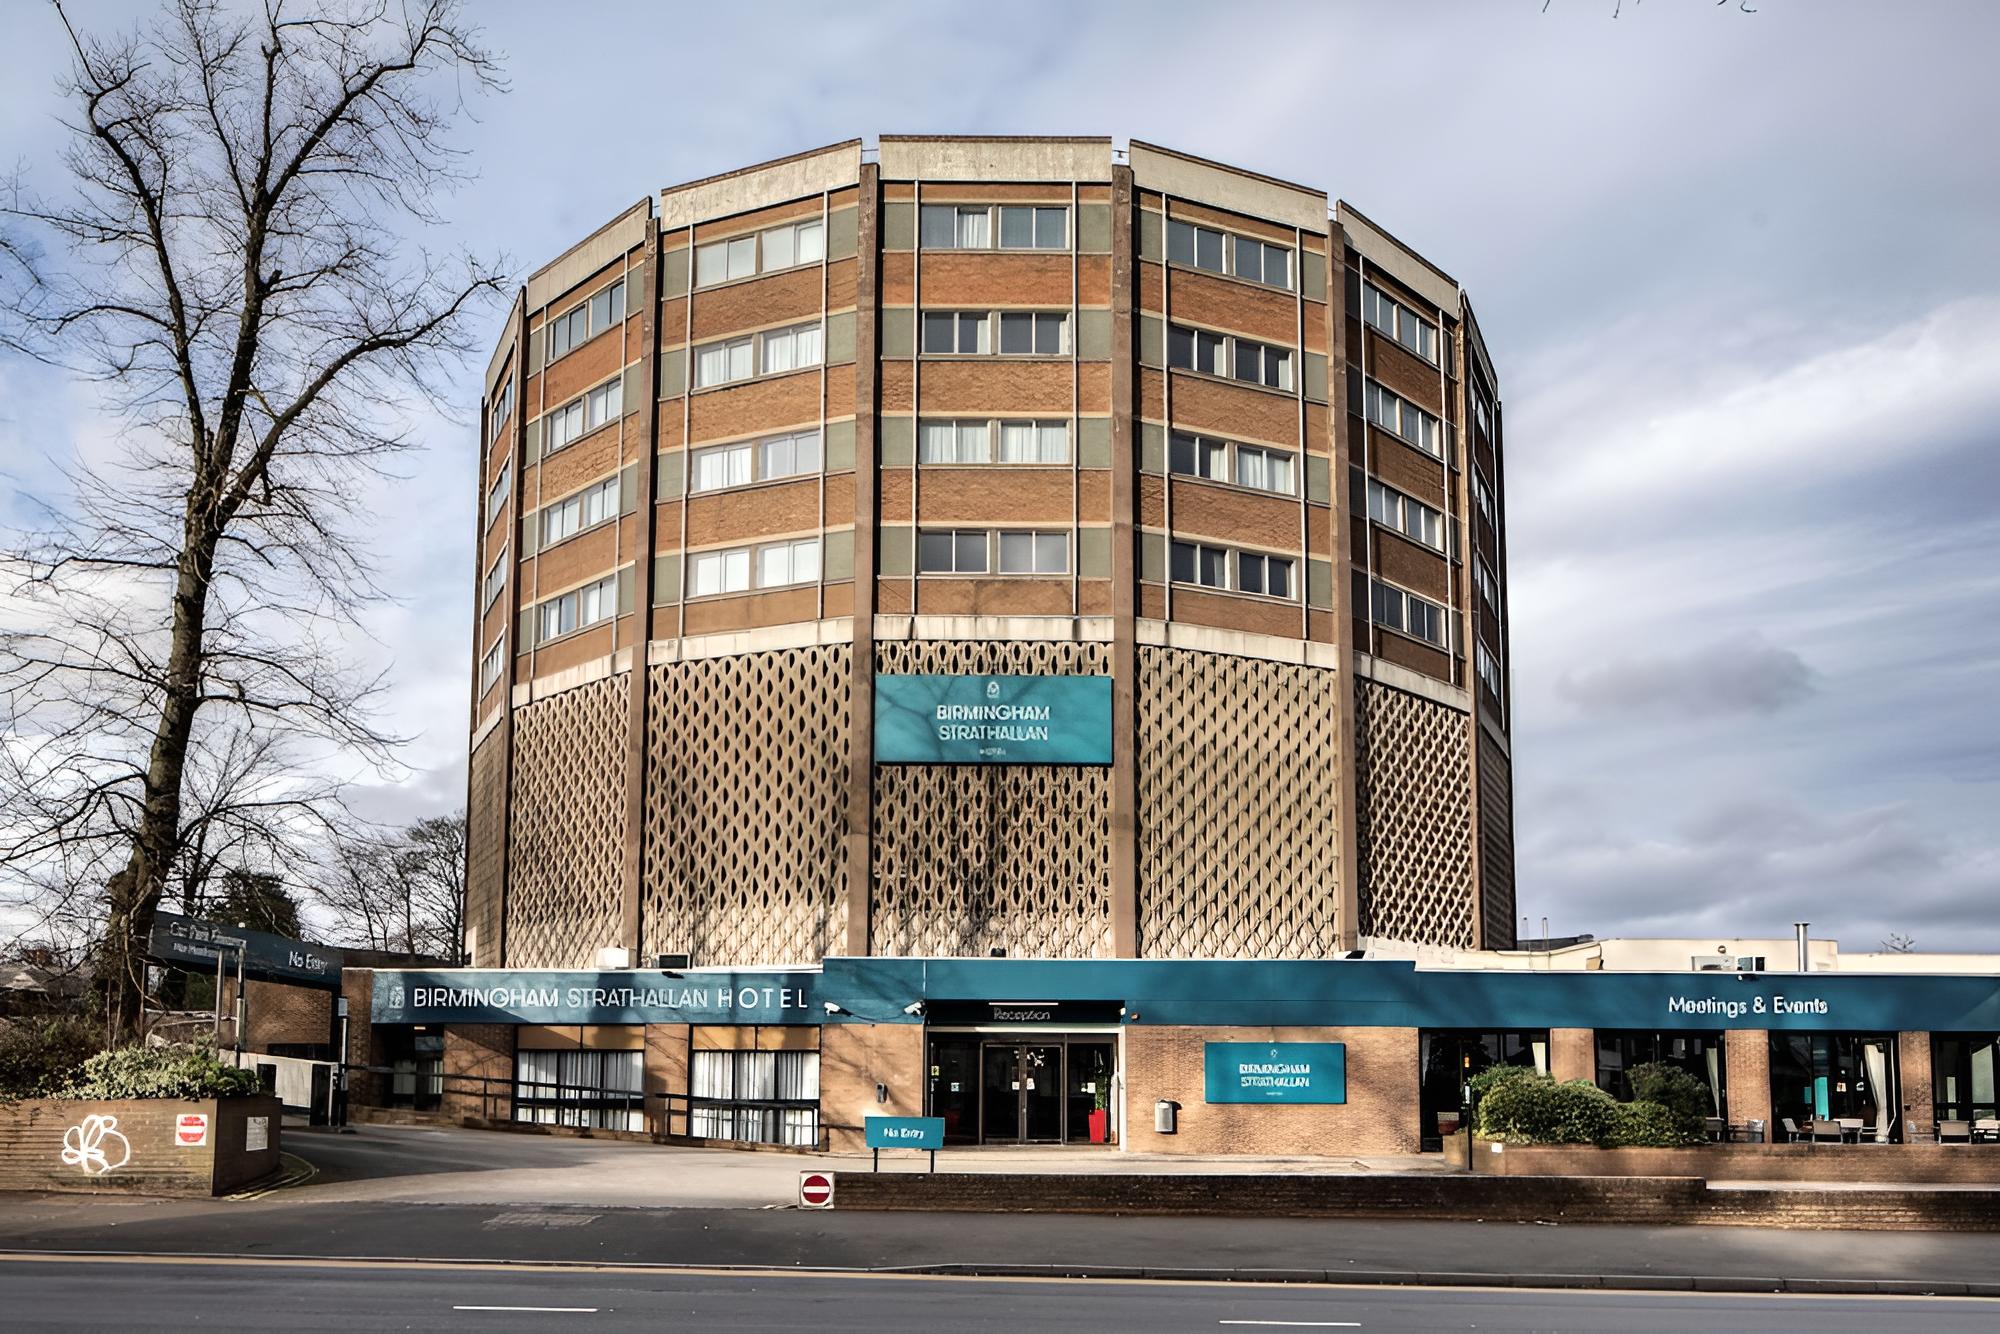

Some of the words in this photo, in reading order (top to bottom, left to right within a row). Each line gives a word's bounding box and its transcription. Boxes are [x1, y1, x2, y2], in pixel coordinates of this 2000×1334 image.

[936, 704, 1050, 721] BIRMINGHAM
[938, 724, 1049, 741] STRATHALLAN
[289, 950, 304, 968] No
[413, 987, 560, 1009] BIRMINGHAM
[565, 987, 708, 1009] STRATHALLAN
[717, 987, 808, 1009] HOTEL
[1668, 996, 1748, 1019] Meetings
[1753, 996, 1767, 1014] &
[1773, 996, 1829, 1015] Events
